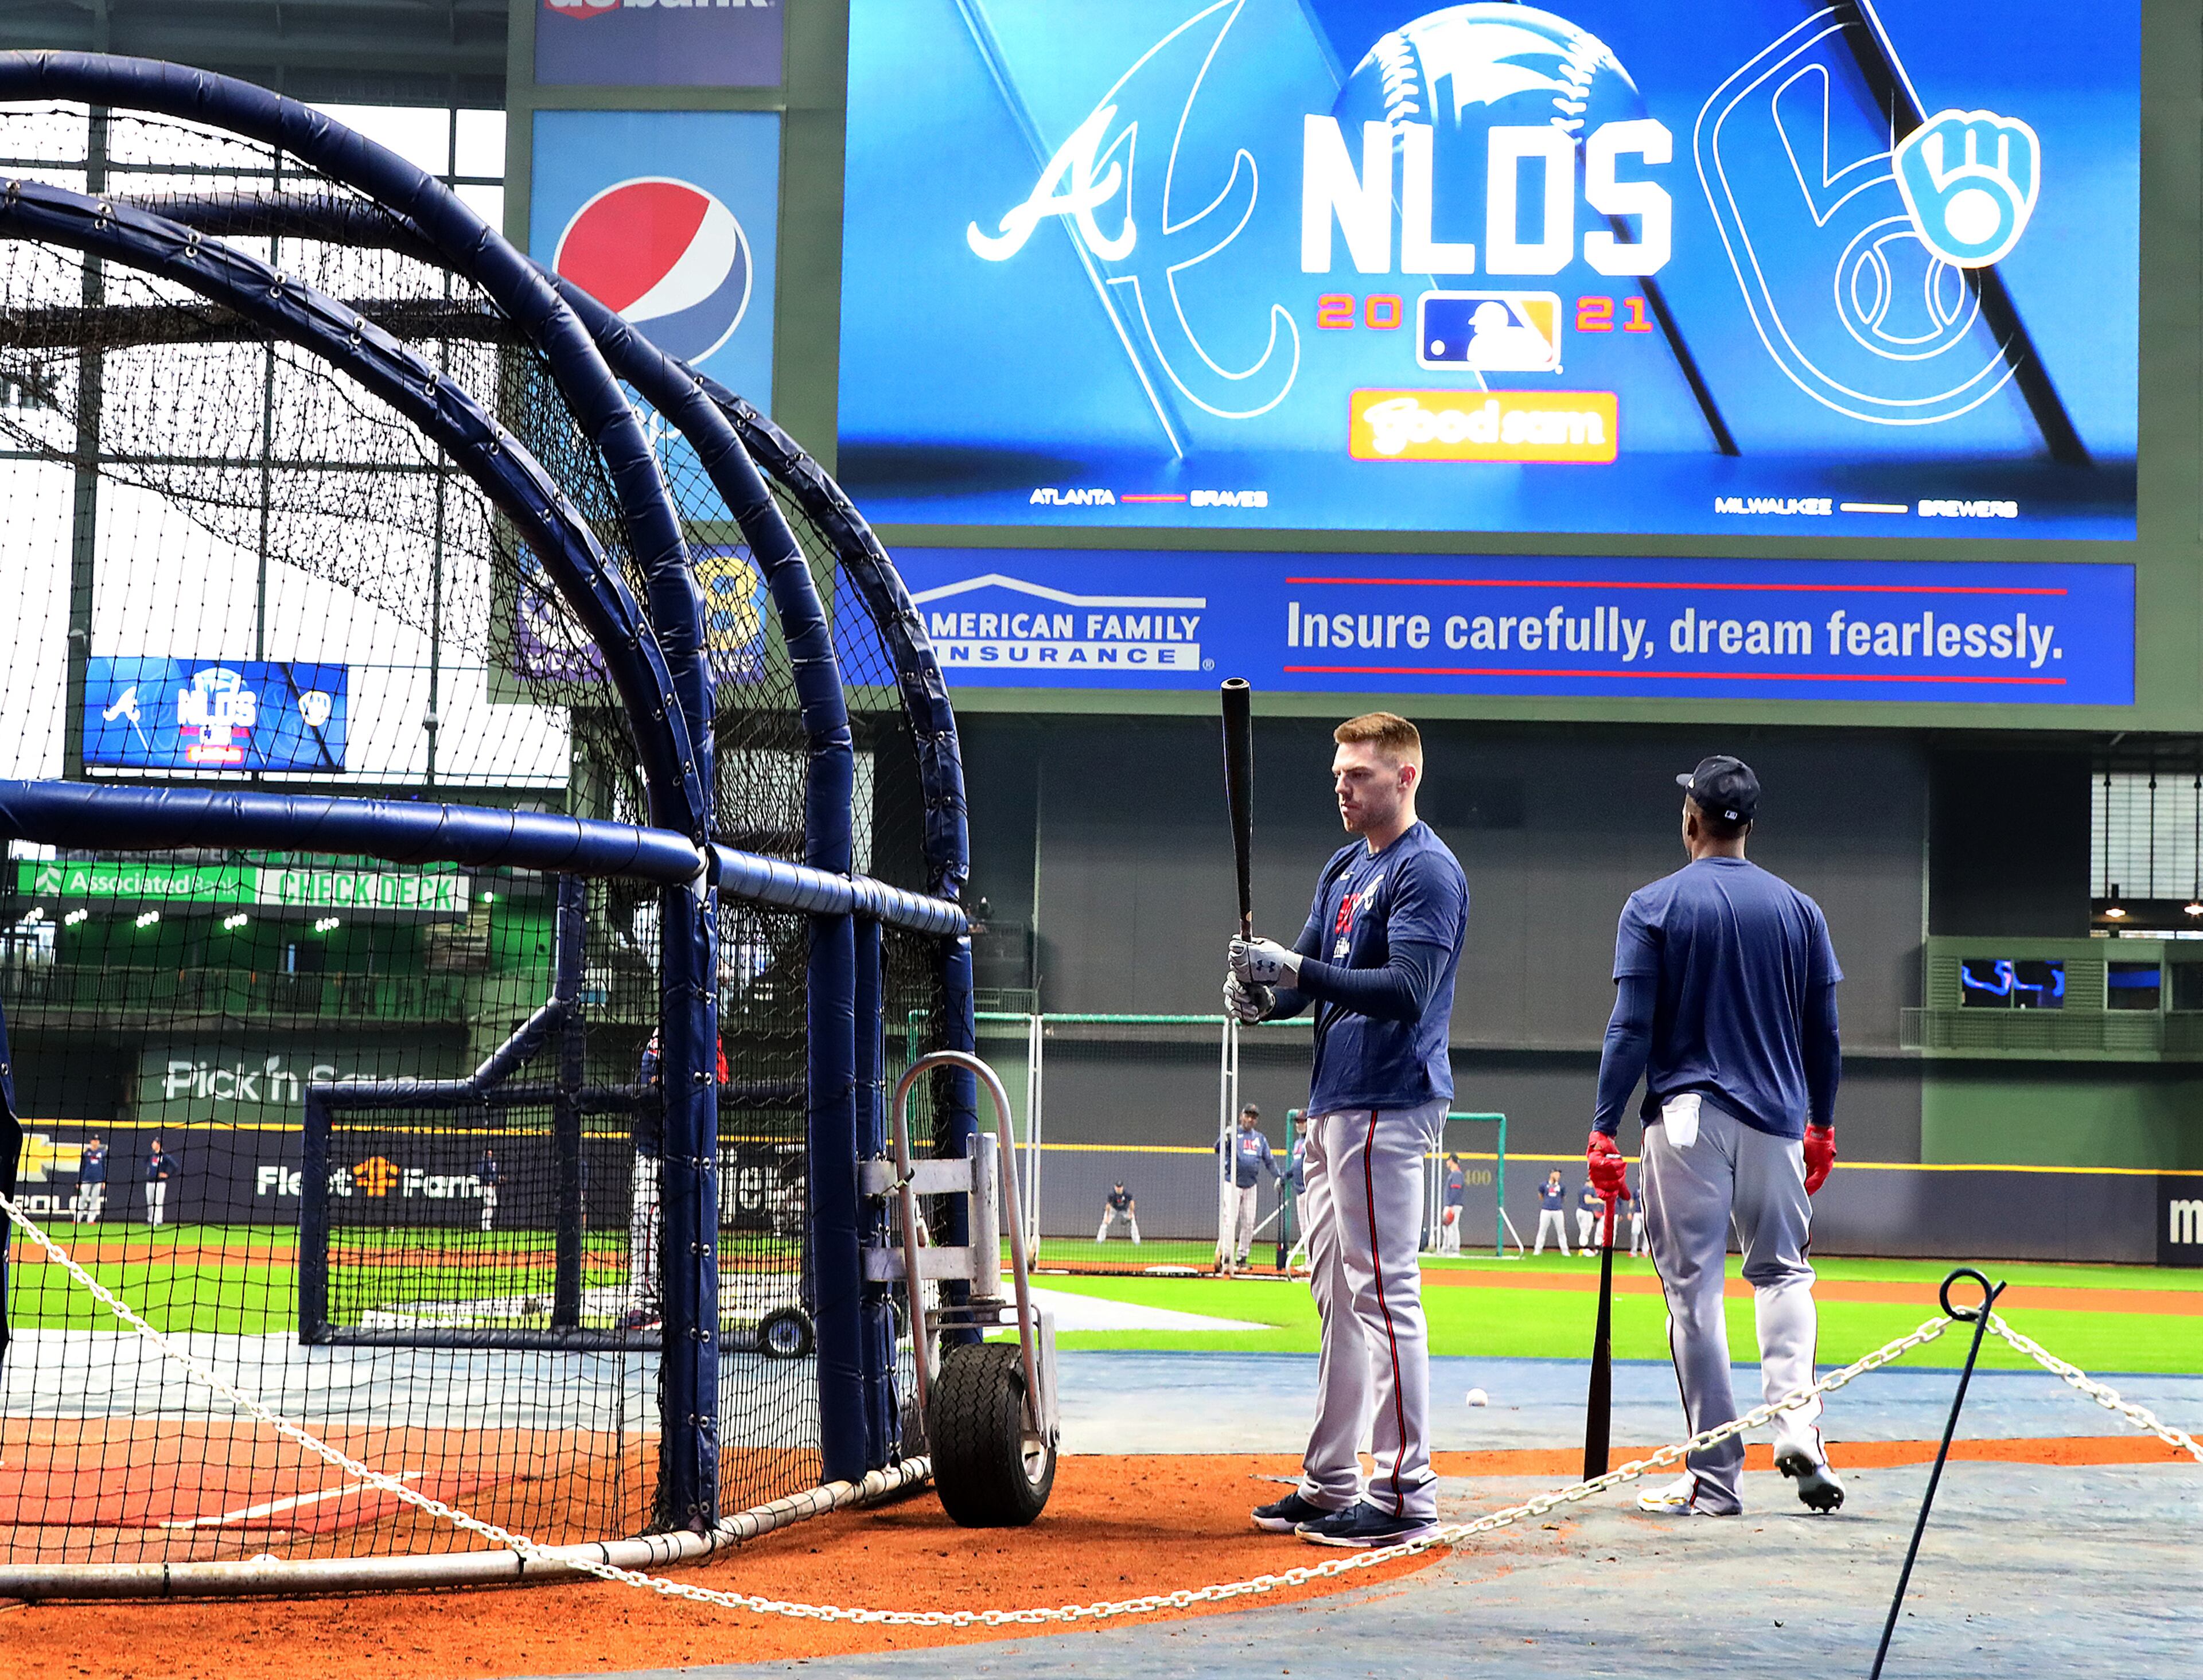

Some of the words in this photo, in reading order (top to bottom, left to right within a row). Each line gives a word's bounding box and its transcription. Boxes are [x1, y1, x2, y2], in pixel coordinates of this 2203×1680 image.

[1301, 114, 1673, 276] NLDS
[1317, 294, 1403, 330] 20
[1575, 296, 1654, 333] 21
[1030, 488, 1116, 505] ATLANTA
[1190, 490, 1268, 508] BRAVES
[1715, 497, 1833, 515] MILWAUKEE
[1917, 499, 2018, 517] BREWERS
[1087, 614, 1201, 641] FAMILY
[1287, 601, 1431, 649] Insure
[1444, 605, 1655, 662] carefully,
[1669, 607, 1813, 655] dream
[1827, 610, 2064, 669] fearlessly.
[69, 871, 189, 894] Associated
[279, 872, 371, 907] CHECK
[380, 876, 452, 910] DECK
